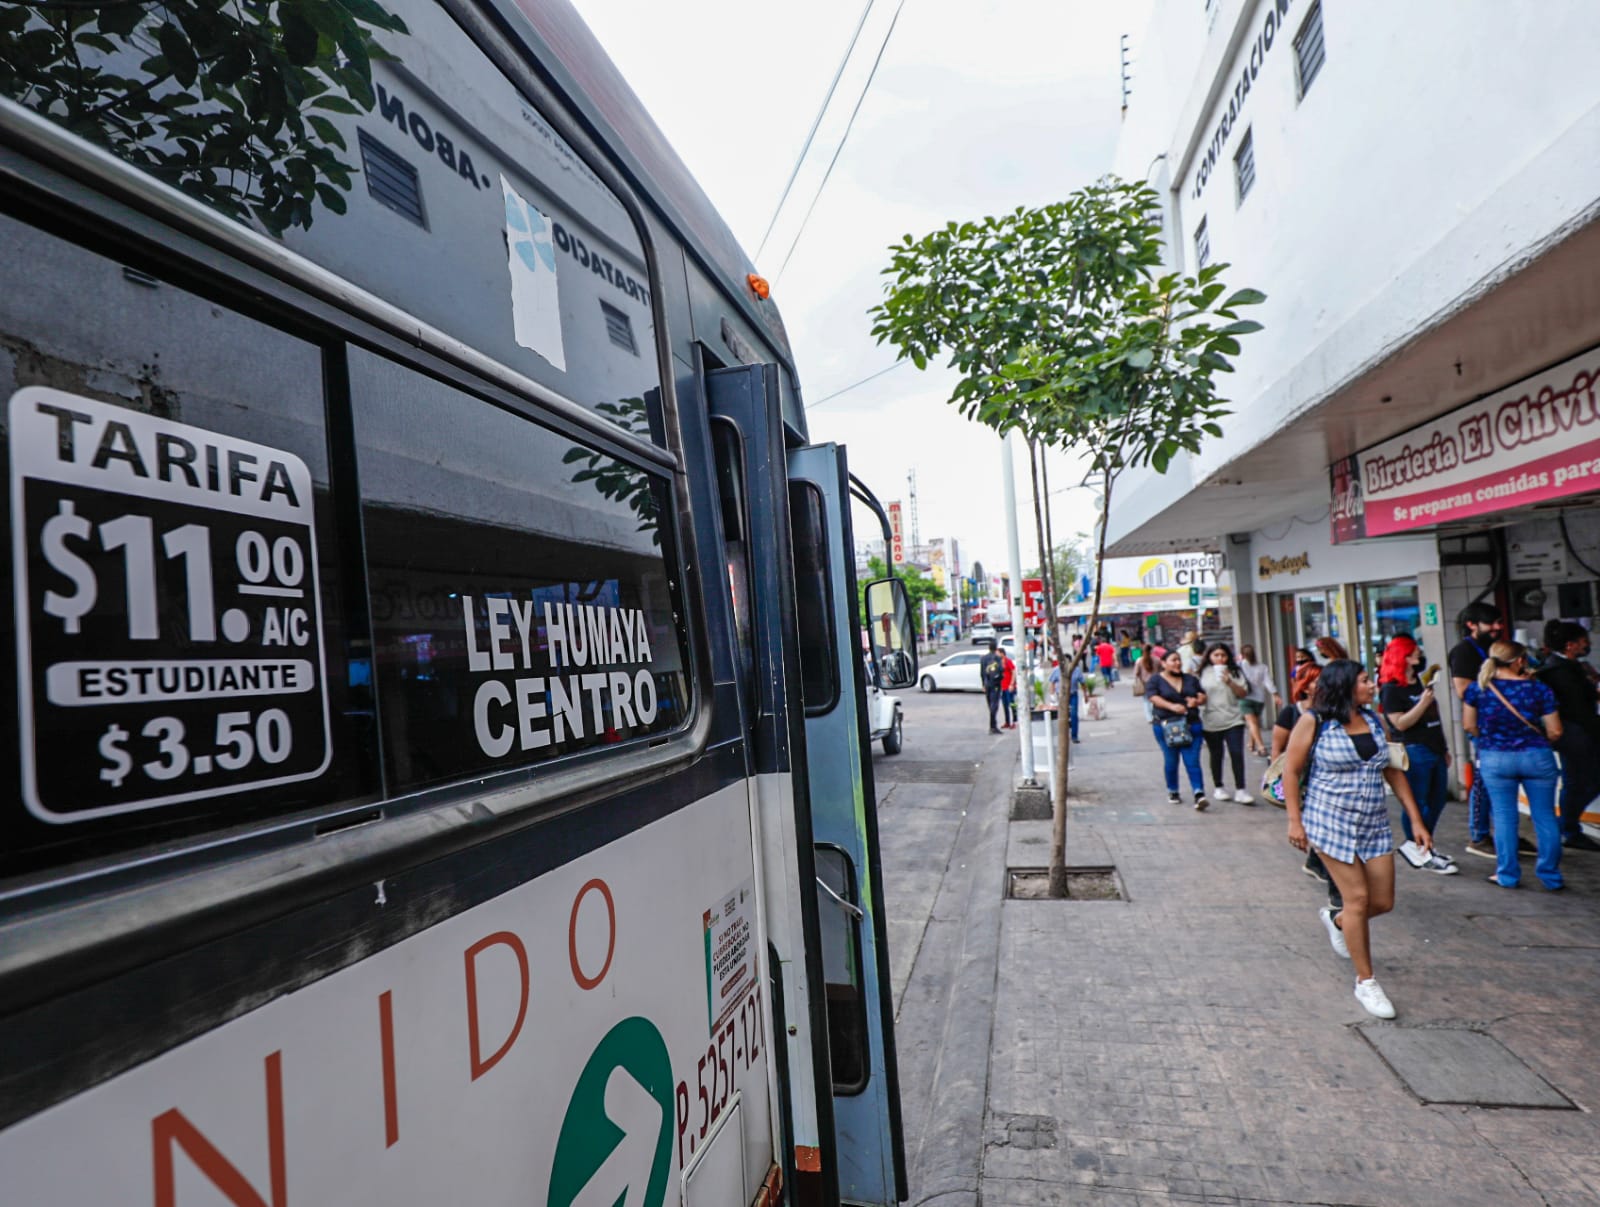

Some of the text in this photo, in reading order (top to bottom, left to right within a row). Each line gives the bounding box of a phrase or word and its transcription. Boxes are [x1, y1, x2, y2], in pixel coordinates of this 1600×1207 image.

[36, 402, 301, 508] TARIFA
[1459, 412, 1494, 463] El
[1393, 506, 1408, 521] Se
[1410, 491, 1473, 521] preparan
[1476, 470, 1549, 503] comidas
[889, 503, 903, 562] milano
[1175, 568, 1223, 585] CITY
[262, 607, 309, 646] A/C
[462, 595, 533, 672] LEY
[543, 601, 653, 668] HUMAYA
[78, 664, 298, 698] ESTUDIANTE
[473, 668, 658, 758] CENTRO
